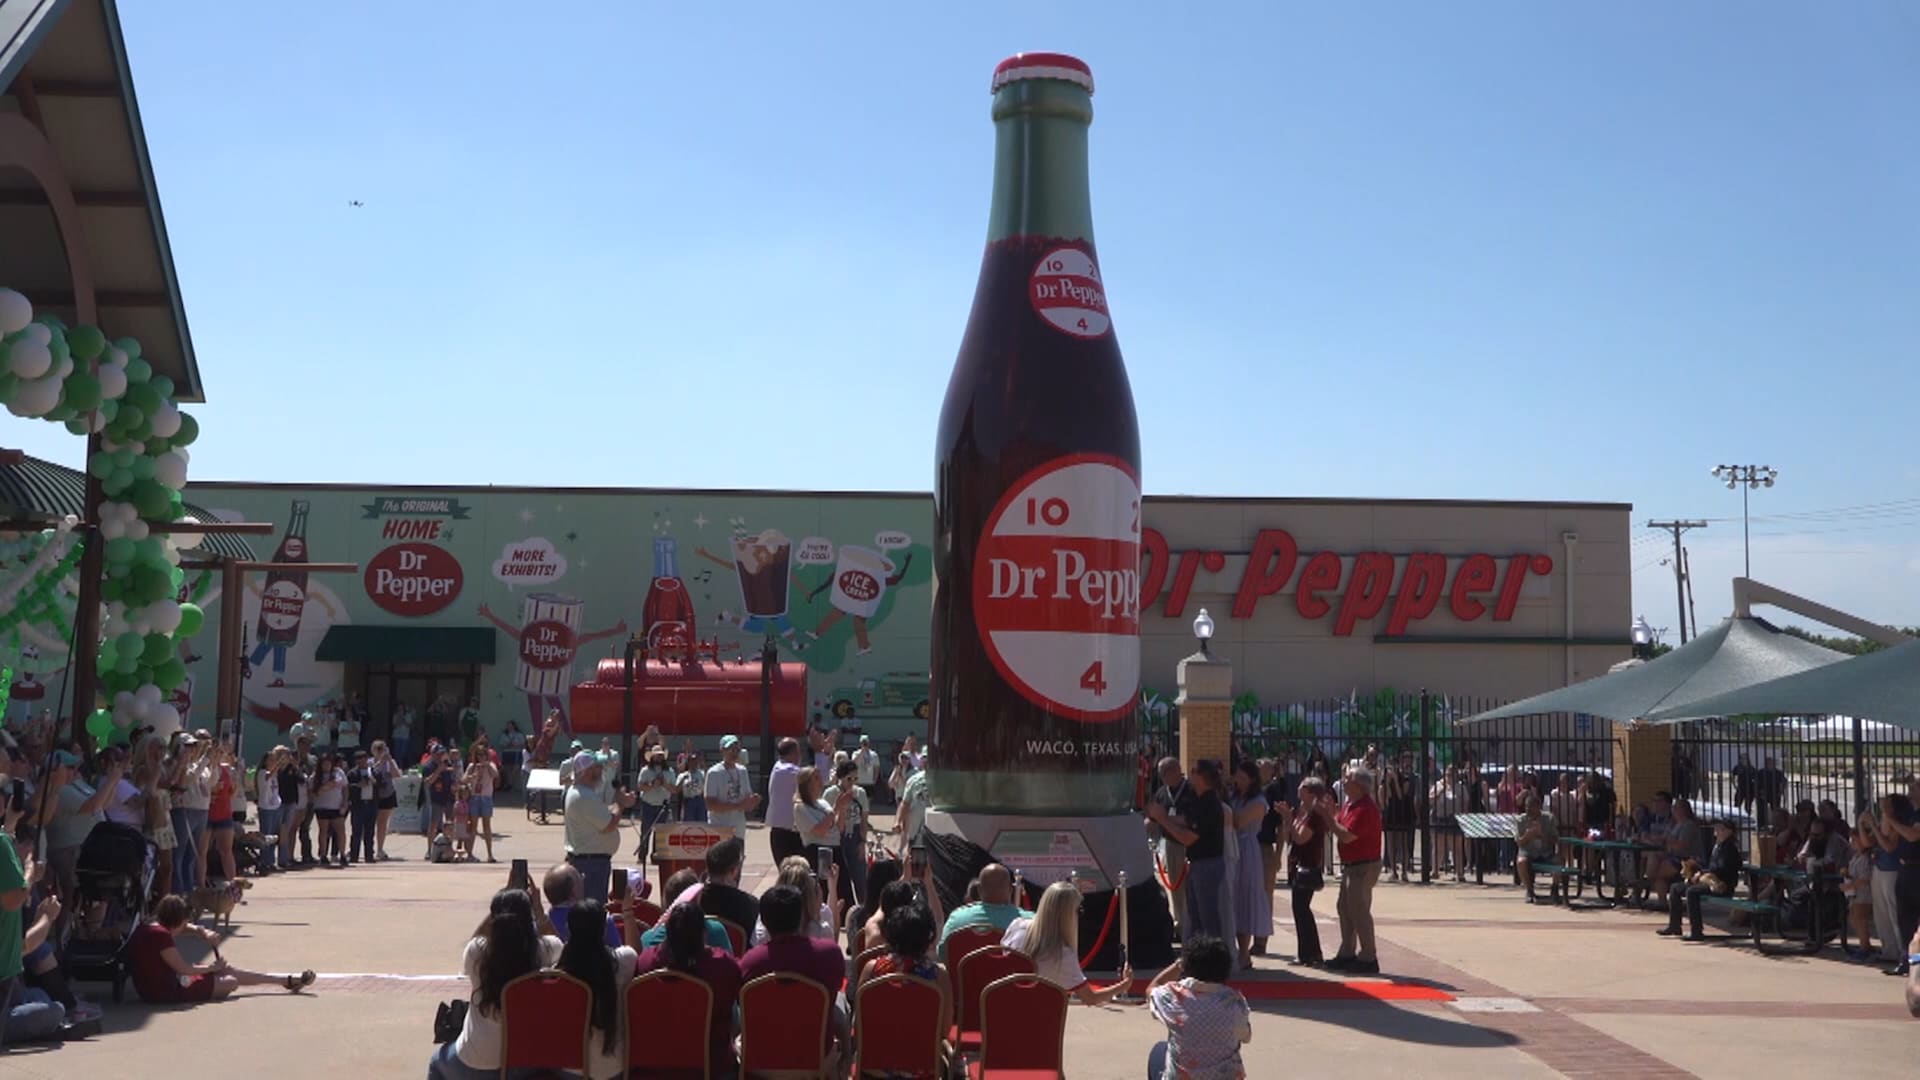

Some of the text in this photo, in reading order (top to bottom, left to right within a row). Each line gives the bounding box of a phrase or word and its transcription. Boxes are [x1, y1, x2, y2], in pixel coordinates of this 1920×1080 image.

[1046, 260, 1064, 272] 10
[1036, 282, 1058, 299] Dr
[1077, 318, 1088, 331] 4
[401, 500, 450, 512] ORIGINAL
[1026, 497, 1070, 527] 10
[383, 519, 443, 540] HOME
[399, 550, 428, 570] Dr
[512, 549, 545, 562] MORE
[501, 564, 557, 577] EXHIBITS!
[375, 568, 455, 602] Pepper
[850, 572, 870, 590] ICE
[988, 549, 1139, 624] Dr Pepp
[1139, 527, 1553, 637] Dr Pepper
[540, 627, 559, 643] Dr
[523, 637, 573, 662] Pepper
[1079, 660, 1107, 696] 4
[1026, 740, 1078, 757] WACO,
